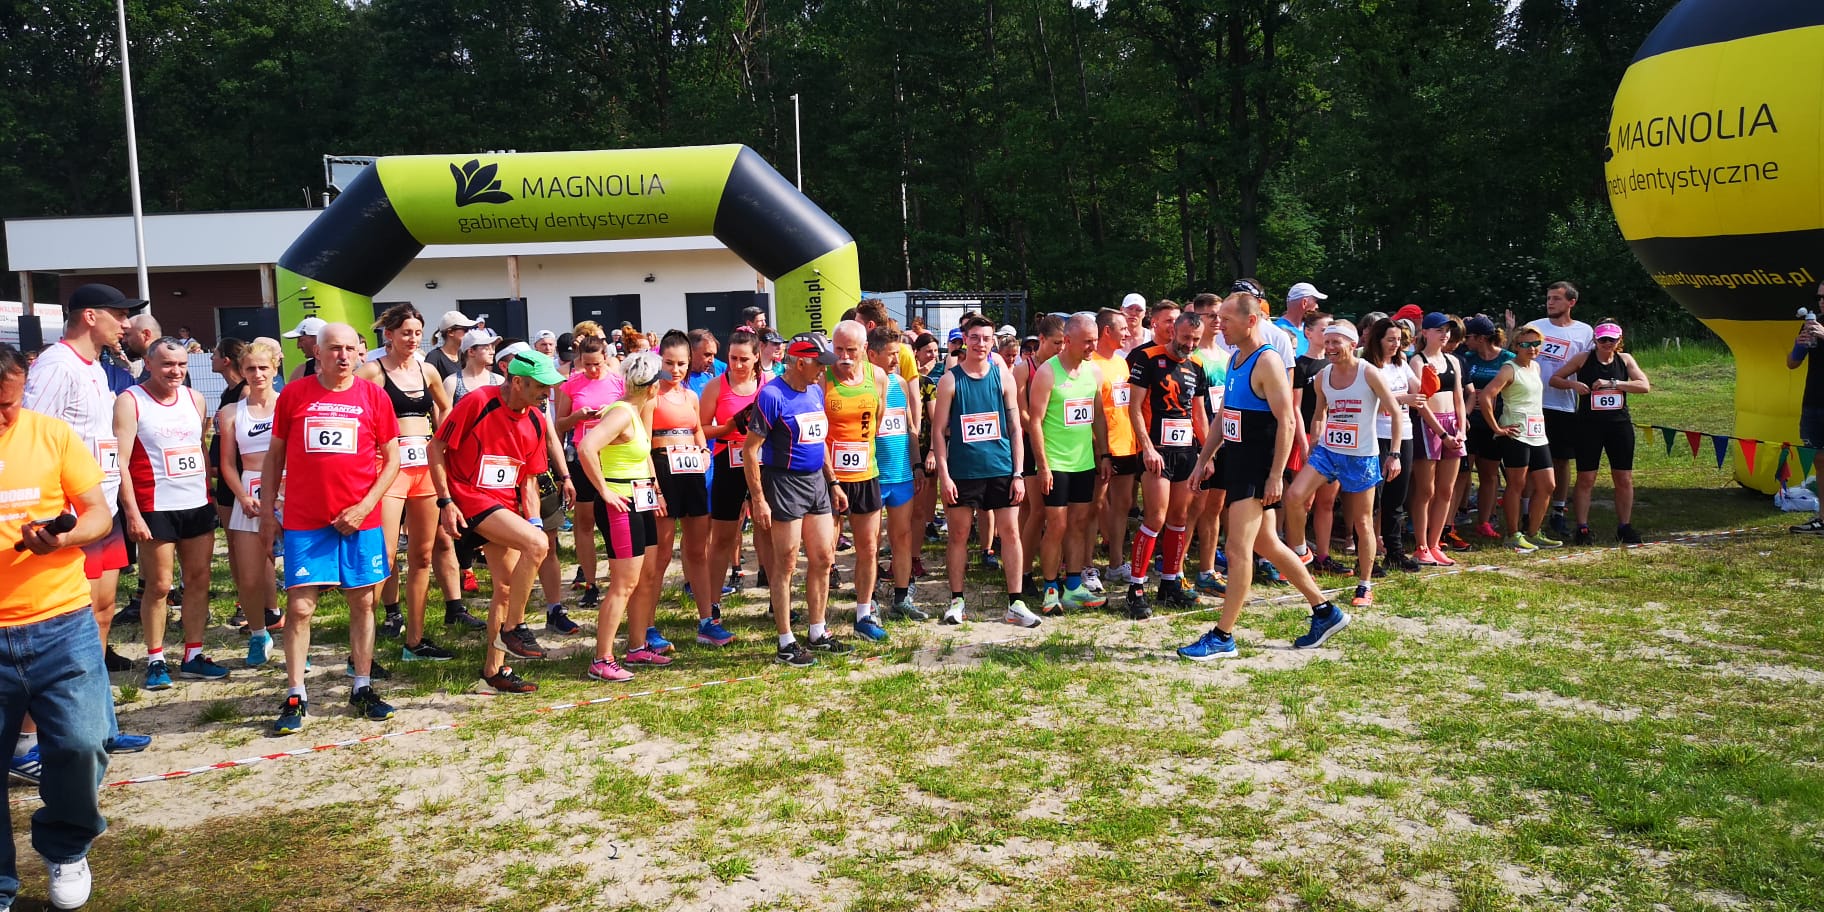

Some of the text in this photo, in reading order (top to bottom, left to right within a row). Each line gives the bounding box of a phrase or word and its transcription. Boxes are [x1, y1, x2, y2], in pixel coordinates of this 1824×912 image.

[1617, 103, 1778, 153] MAGNOLIA
[1629, 161, 1778, 195] dentystyczne
[521, 173, 665, 198] MAGNOLIA
[458, 209, 669, 234] gabinety dentystyczne
[1544, 343, 1560, 354] 27
[1600, 396, 1615, 406] 69
[1073, 408, 1088, 420] 20
[253, 421, 272, 430] NIKE
[808, 424, 821, 437] 45
[884, 418, 901, 431] 98
[967, 423, 993, 436] 267
[1225, 421, 1236, 436] 148
[319, 430, 342, 446] 62
[1171, 429, 1185, 441] 67
[1328, 431, 1352, 445] 139
[407, 447, 426, 460] 89
[842, 453, 860, 466] 99
[178, 456, 197, 471] 58
[676, 455, 699, 468] 100
[496, 469, 506, 482] 9
